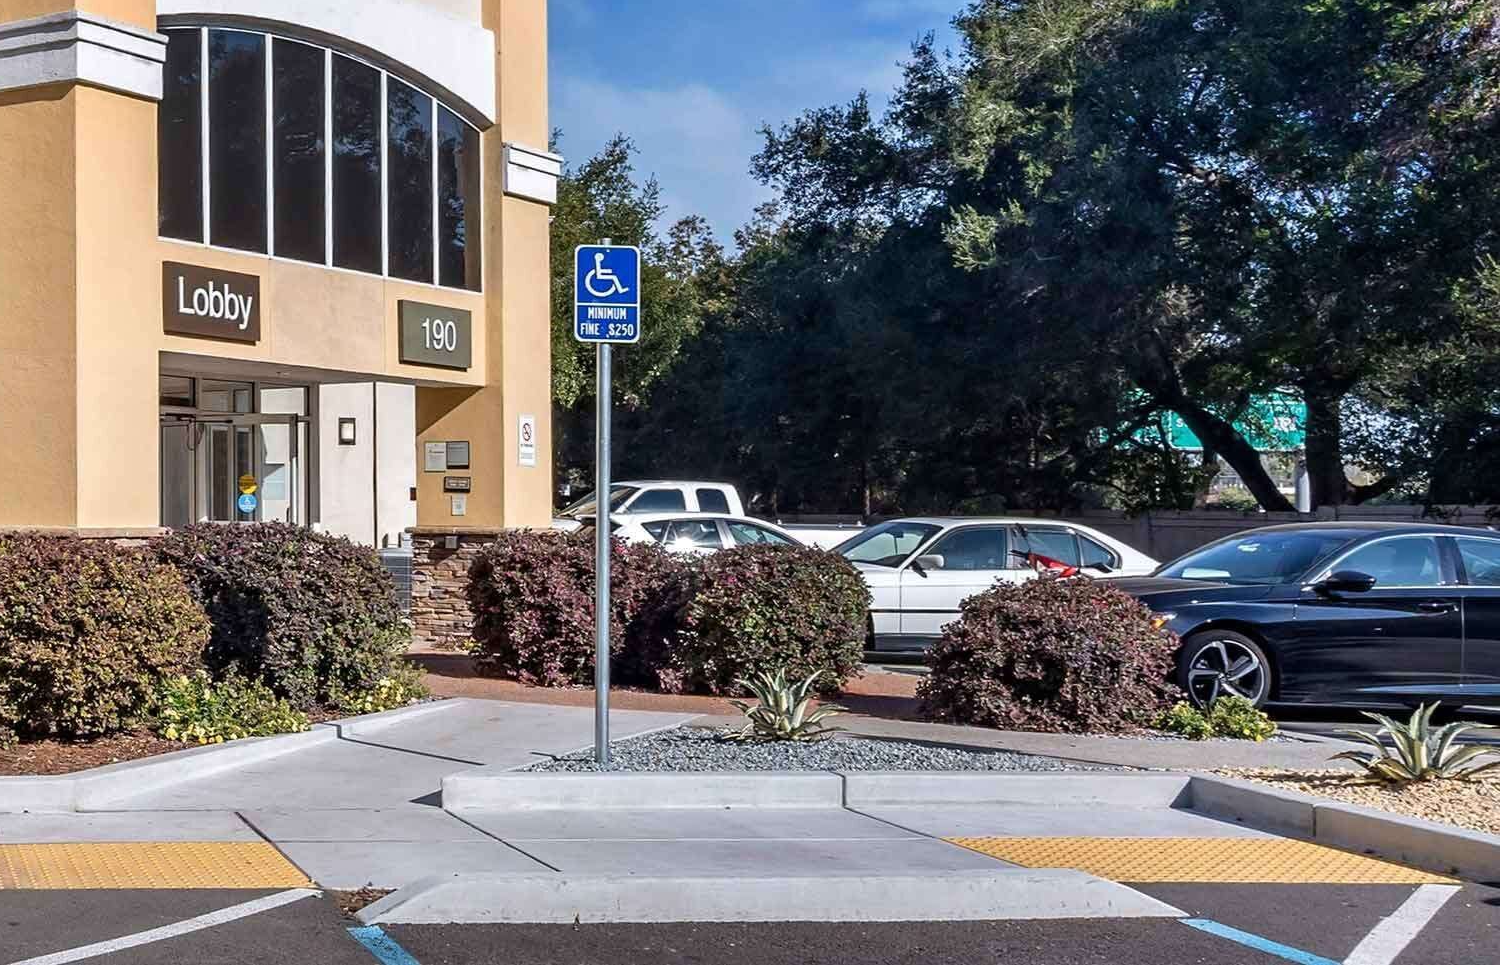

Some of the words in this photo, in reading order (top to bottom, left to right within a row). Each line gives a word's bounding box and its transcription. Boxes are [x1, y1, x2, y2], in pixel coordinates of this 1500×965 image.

[177, 275, 253, 330] Lobby
[587, 306, 627, 320] MINIMUM
[421, 317, 457, 352] 190
[580, 322, 600, 335] FINE
[608, 323, 634, 336] $250
